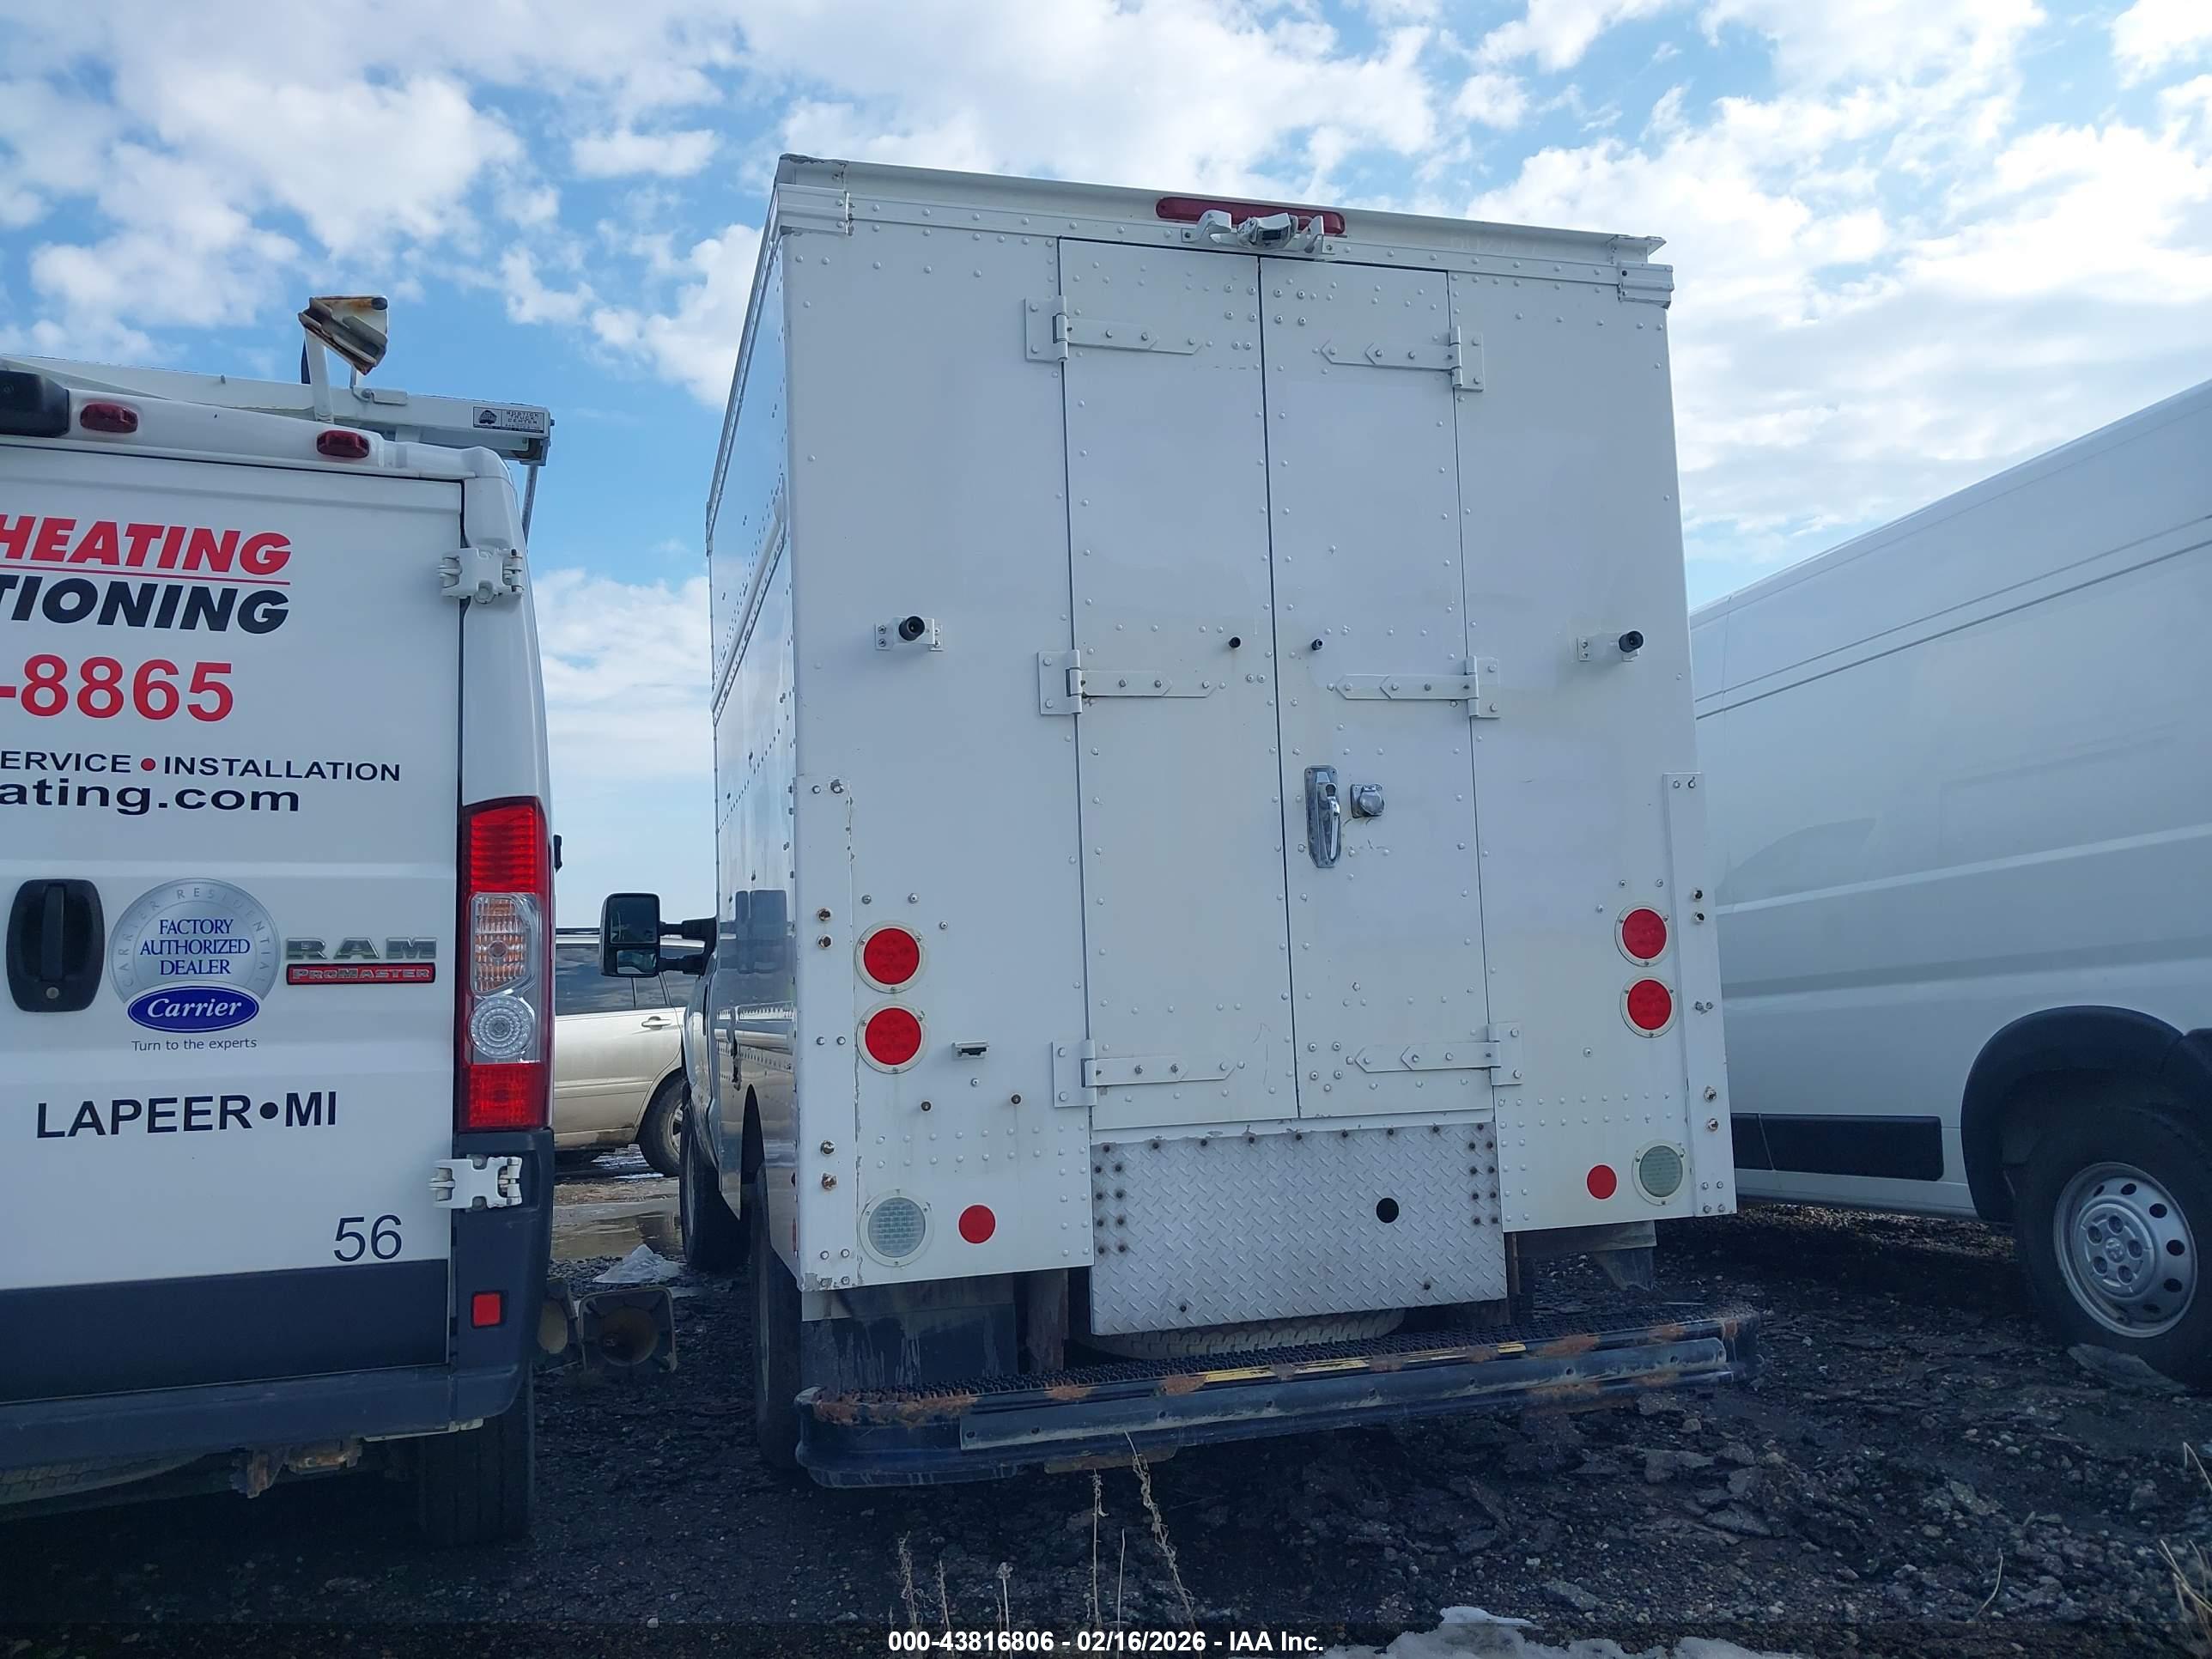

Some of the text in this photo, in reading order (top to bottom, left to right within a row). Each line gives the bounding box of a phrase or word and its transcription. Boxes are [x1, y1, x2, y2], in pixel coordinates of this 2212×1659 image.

[0, 514, 291, 574] HEATING
[164, 756, 401, 781] INSTALLATION
[159, 919, 234, 934] FACTORY
[139, 939, 251, 956] AUTHORIZED
[286, 937, 437, 960] RAM
[160, 959, 232, 975] DEALER
[147, 998, 242, 1018] Carrier
[131, 1037, 258, 1052] Turn to the experts
[333, 1214, 403, 1262] 56
